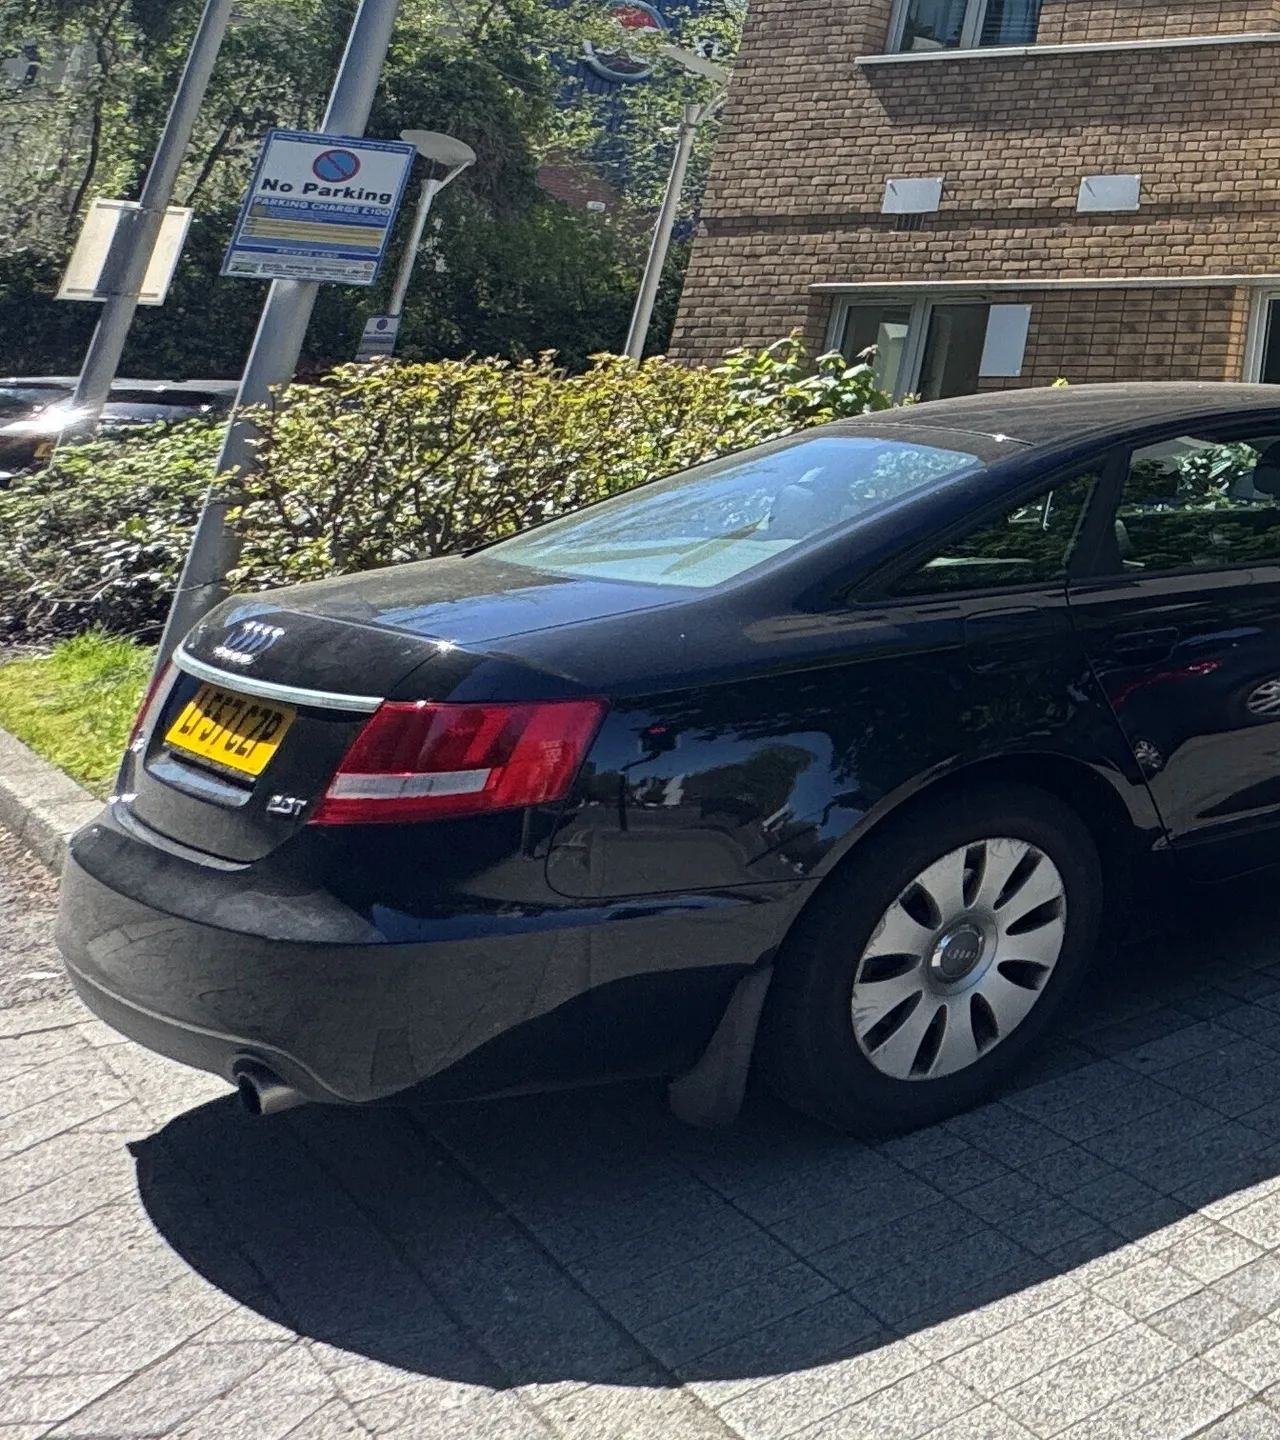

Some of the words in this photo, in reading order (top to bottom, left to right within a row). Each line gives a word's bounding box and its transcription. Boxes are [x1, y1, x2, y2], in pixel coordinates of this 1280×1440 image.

[261, 178, 293, 193] No
[302, 182, 392, 204] Parking
[253, 197, 309, 210] PARKING
[311, 203, 359, 214] CHARGE
